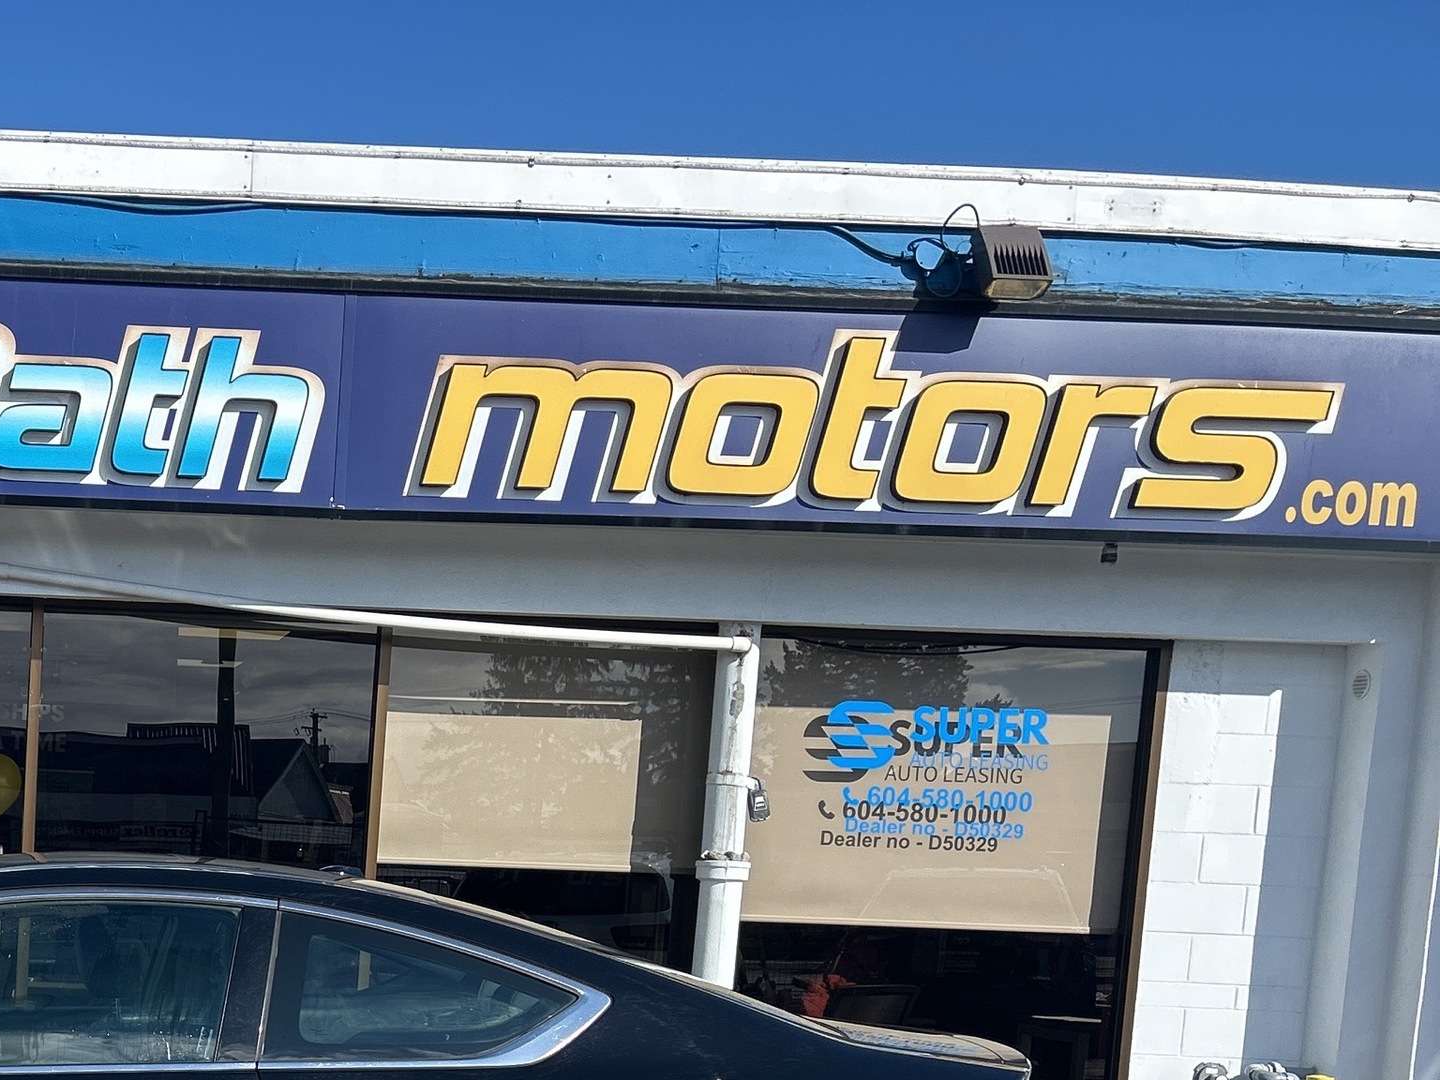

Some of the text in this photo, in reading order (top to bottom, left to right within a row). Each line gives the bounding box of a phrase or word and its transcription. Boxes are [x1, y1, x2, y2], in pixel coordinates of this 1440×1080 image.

[402, 328, 1344, 520] motors
[910, 705, 1048, 746] SUPER
[11, 731, 66, 752] TME
[867, 786, 1033, 813] 604-580-1000
[820, 830, 881, 847] Dealer
[887, 836, 910, 849] no
[928, 835, 998, 852] D50329
